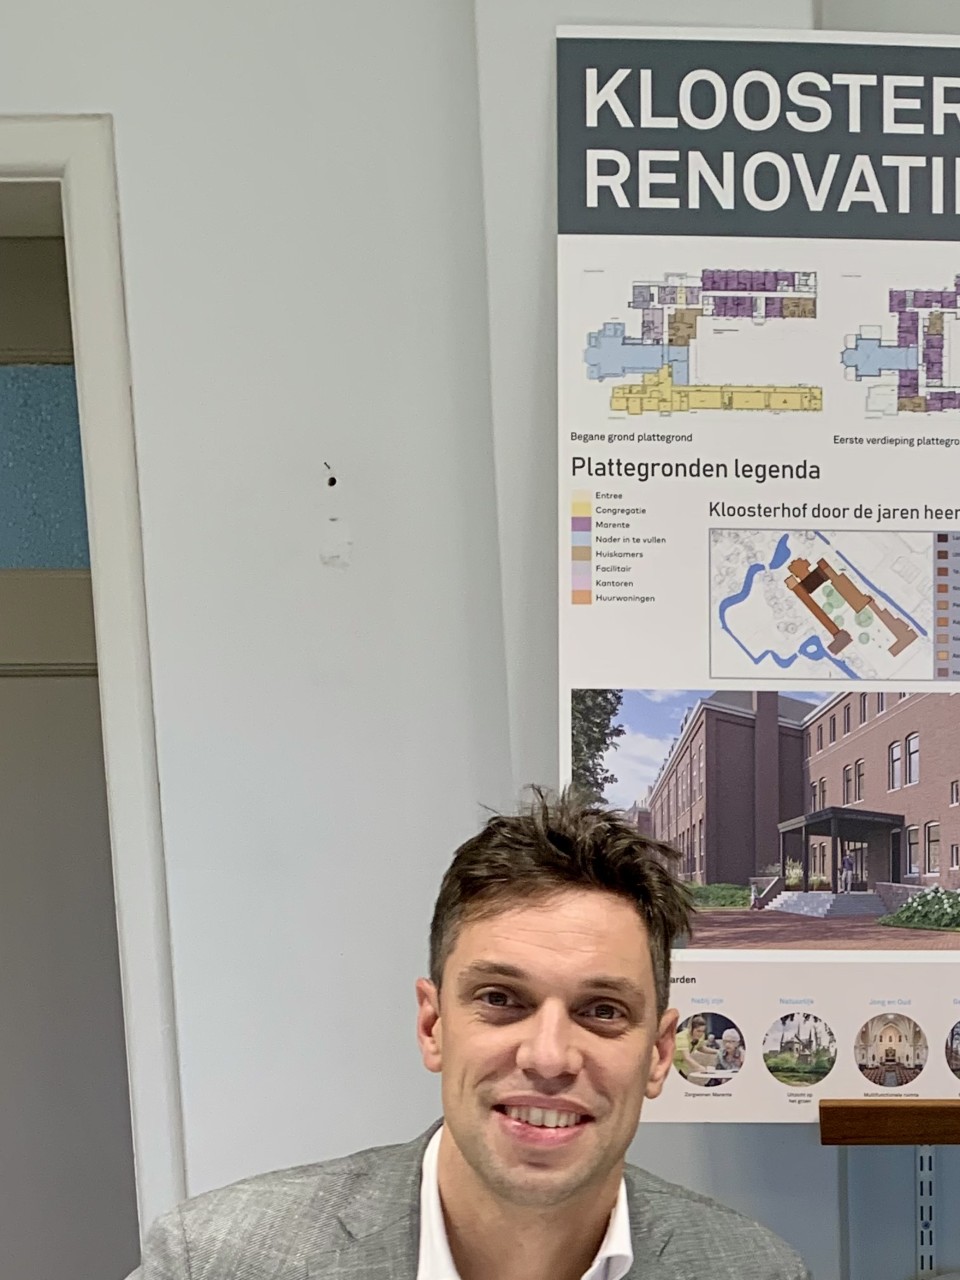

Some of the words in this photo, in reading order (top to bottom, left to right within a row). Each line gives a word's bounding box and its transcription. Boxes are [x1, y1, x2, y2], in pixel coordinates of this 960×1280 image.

[570, 432, 605, 443] Begane
[608, 433, 635, 443] grond
[637, 433, 693, 444] plattegrond
[833, 435, 864, 446] Eerste
[866, 436, 915, 448] verdieping
[572, 456, 728, 482] Plattegronden
[734, 458, 821, 484] legenda
[595, 491, 623, 500] Entree
[595, 506, 647, 516] Congregatie
[709, 502, 808, 518] Kloosterhof
[811, 503, 850, 519] door
[853, 504, 873, 519] de
[876, 504, 920, 523] jaren
[595, 521, 630, 529] Marente
[622, 536, 630, 544] in
[595, 550, 644, 558] Huiskamers
[595, 564, 632, 572] Facilitair
[595, 580, 634, 588] Kantoren
[595, 594, 656, 604] Huurwoningen
